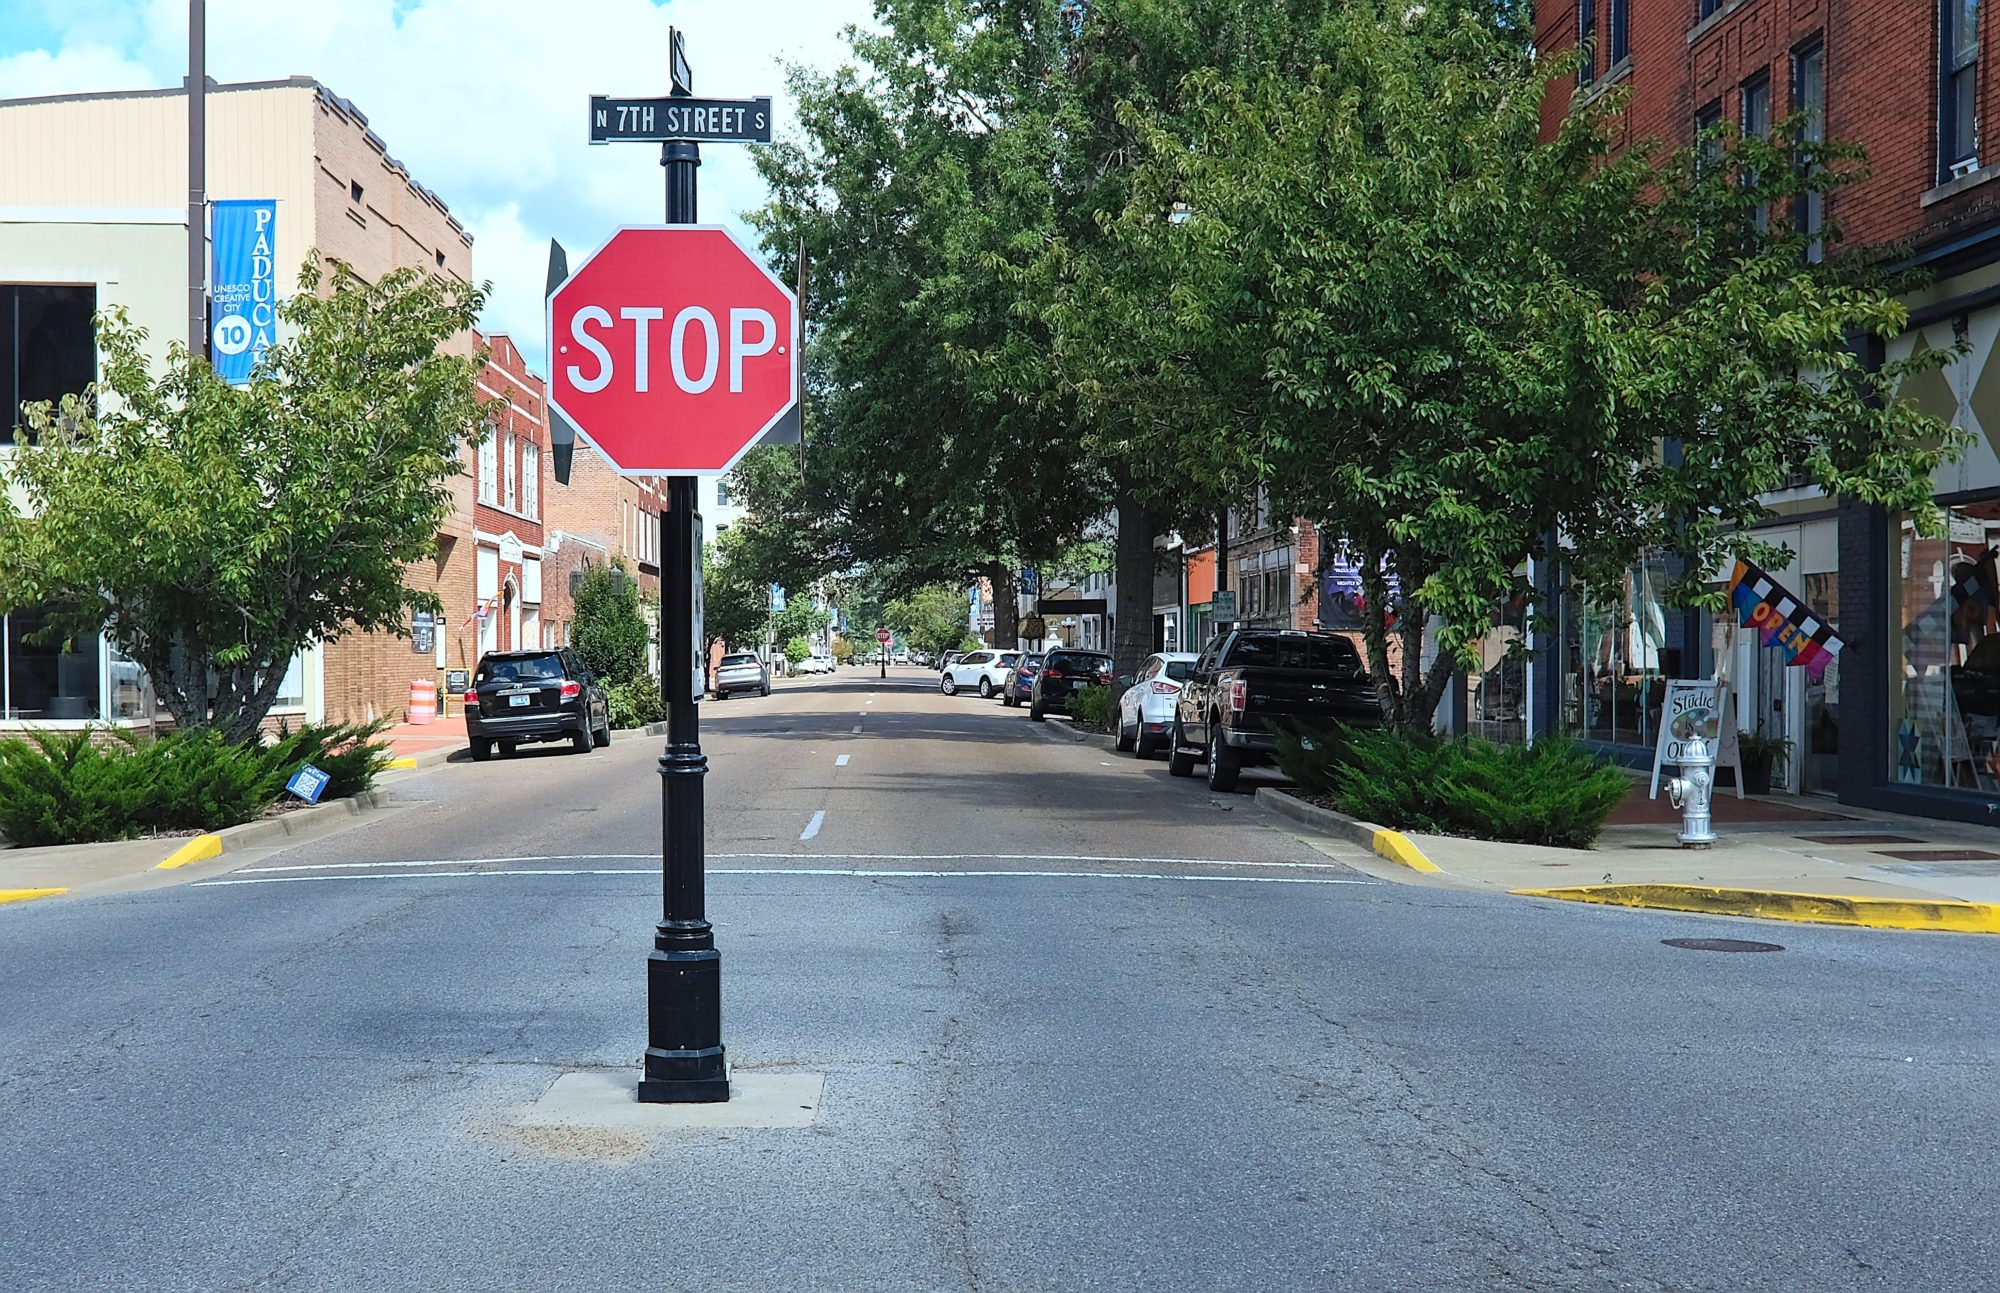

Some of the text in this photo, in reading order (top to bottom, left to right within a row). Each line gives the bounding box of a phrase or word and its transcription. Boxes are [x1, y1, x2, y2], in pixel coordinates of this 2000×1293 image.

[596, 106, 765, 133] N 7TH STREET S
[214, 284, 251, 293] UNESCO
[214, 294, 250, 303] CREATIVE
[223, 304, 241, 313] CITY
[221, 325, 245, 345] 10
[566, 305, 777, 395] STOP
[1752, 601, 1811, 656] OPEN
